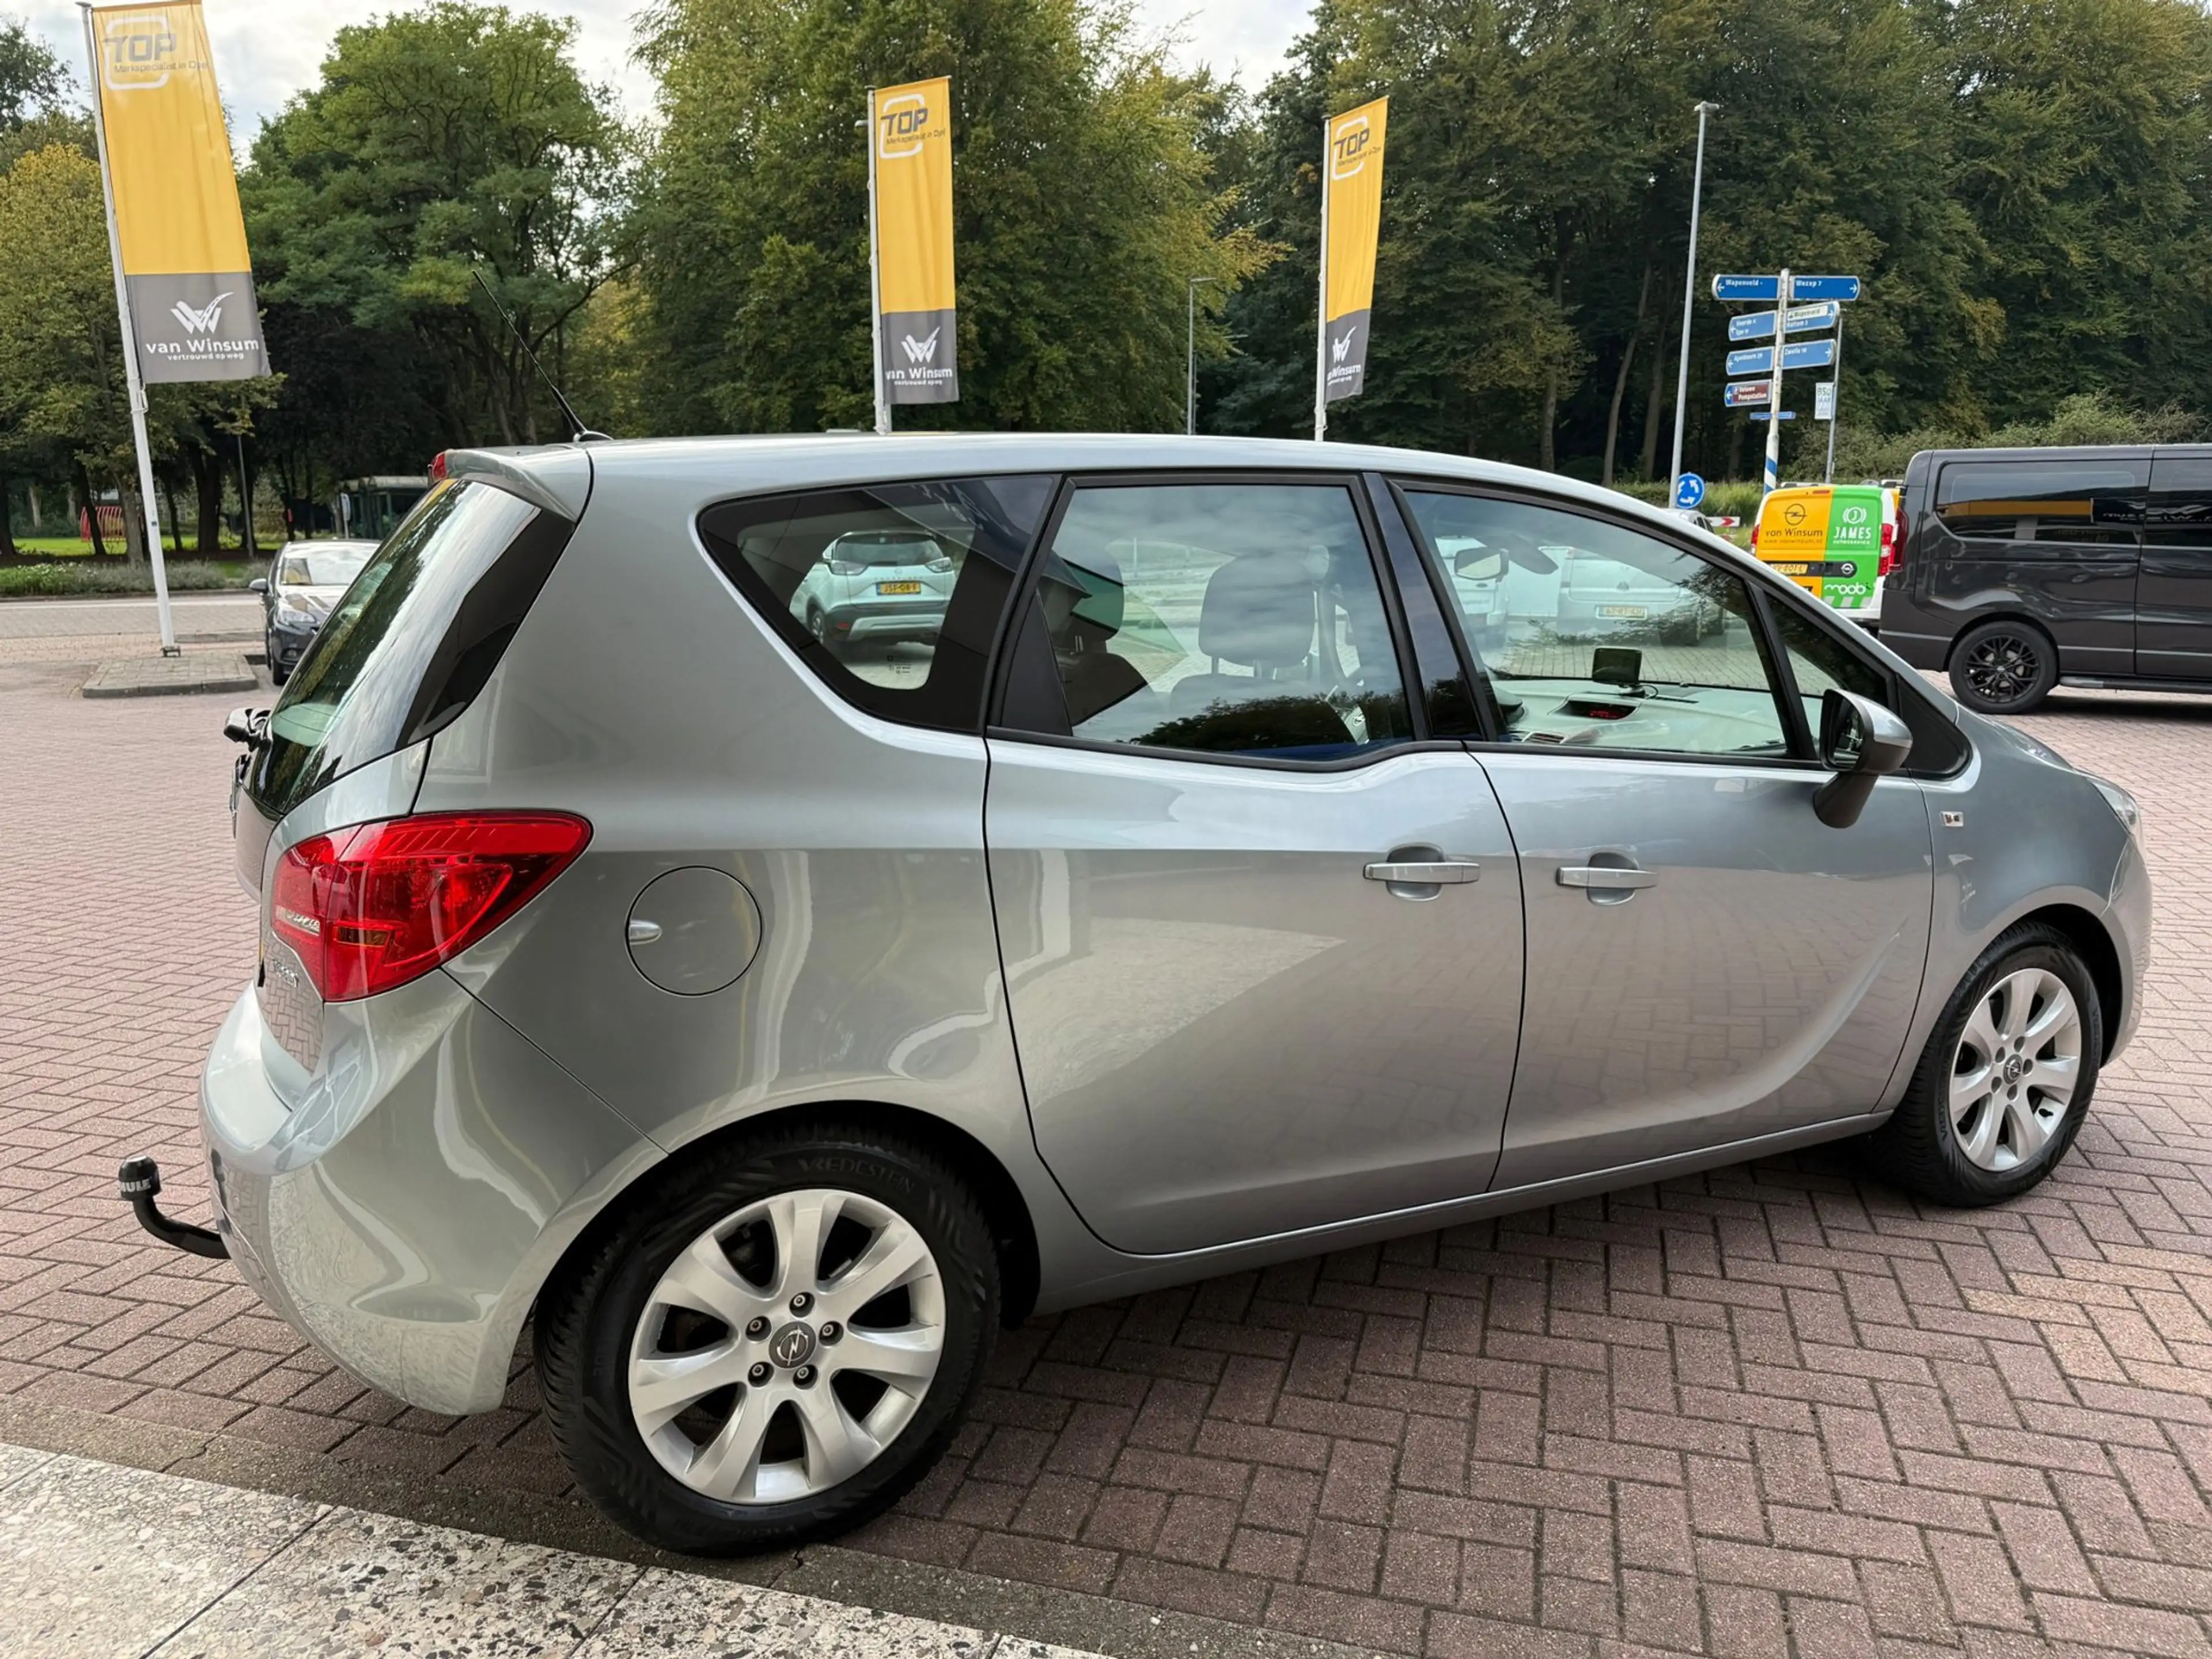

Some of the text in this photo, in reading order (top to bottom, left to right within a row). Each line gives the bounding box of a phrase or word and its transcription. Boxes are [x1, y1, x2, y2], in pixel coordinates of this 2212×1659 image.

[102, 33, 177, 63] TOP
[880, 108, 929, 136] TOP
[1334, 127, 1370, 159] TOP
[1725, 279, 1759, 287] Wapenveld
[146, 338, 259, 354] van Winsum
[166, 353, 214, 361] vertrouwd
[1785, 527, 1823, 537] Winsum
[1833, 527, 1872, 539] JAMES
[797, 1156, 915, 1194] VREDESTEIN
